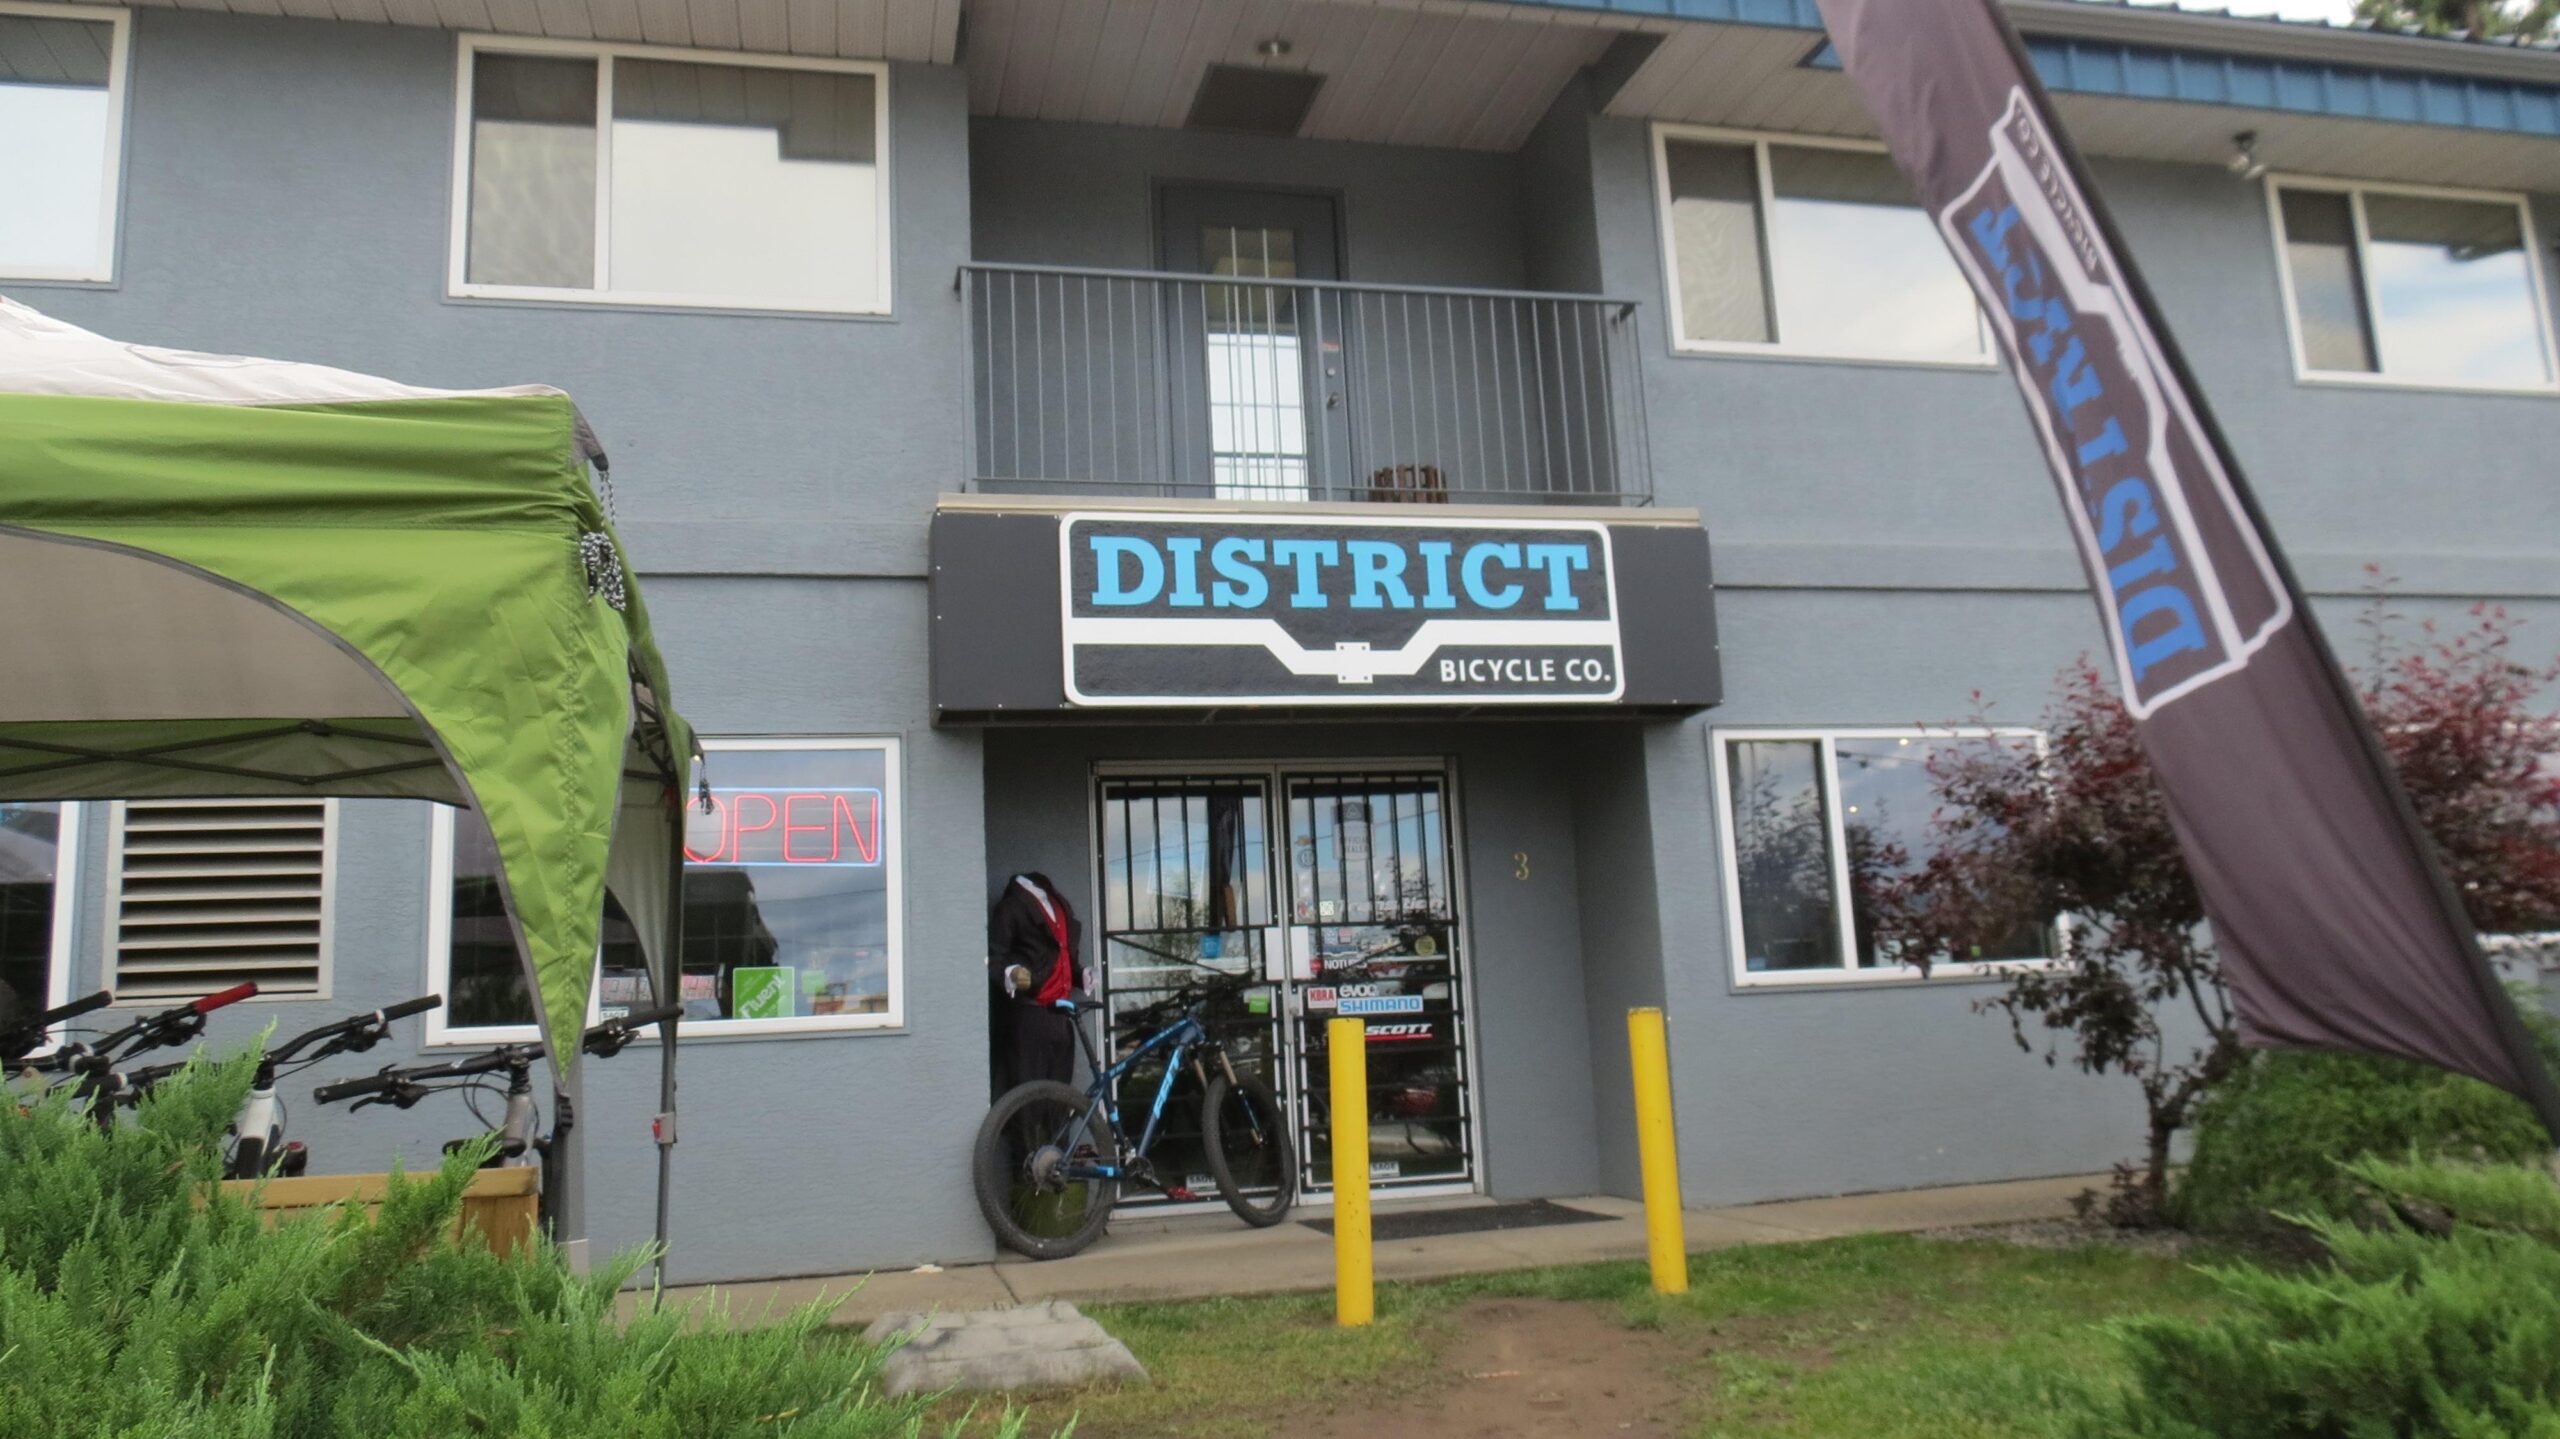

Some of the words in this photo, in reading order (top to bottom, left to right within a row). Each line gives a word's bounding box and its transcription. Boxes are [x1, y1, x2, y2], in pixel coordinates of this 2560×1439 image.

[1089, 535, 1590, 611] DISTRICT
[1439, 657, 1558, 683] BICYCLE
[1564, 658, 1613, 684] CO.
[683, 793, 879, 864] OPEN
[1513, 851, 1530, 881] 3
[1340, 998, 1421, 1013] SHIMANO
[1365, 1022, 1433, 1035] SCOTT
